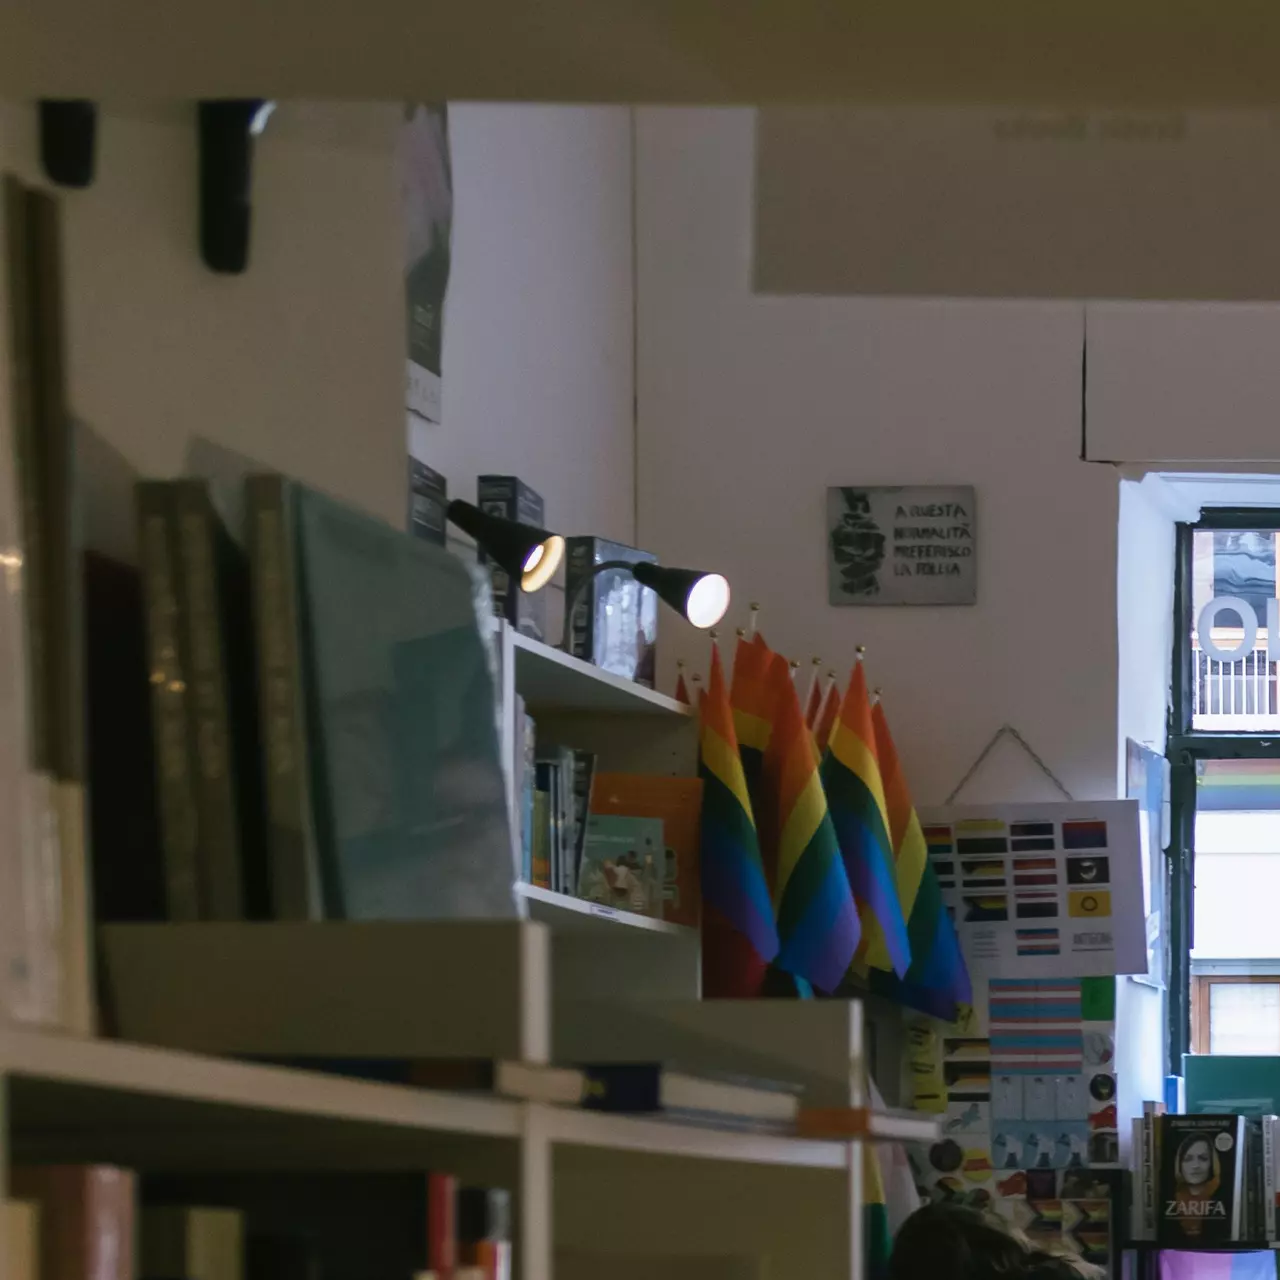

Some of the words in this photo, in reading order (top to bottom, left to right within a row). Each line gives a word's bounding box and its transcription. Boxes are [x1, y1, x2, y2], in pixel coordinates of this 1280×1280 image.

[895, 505, 907, 520] A
[909, 504, 967, 518] QUESTA
[893, 563, 912, 576] LA
[1165, 1200, 1227, 1216] ZARIFA
